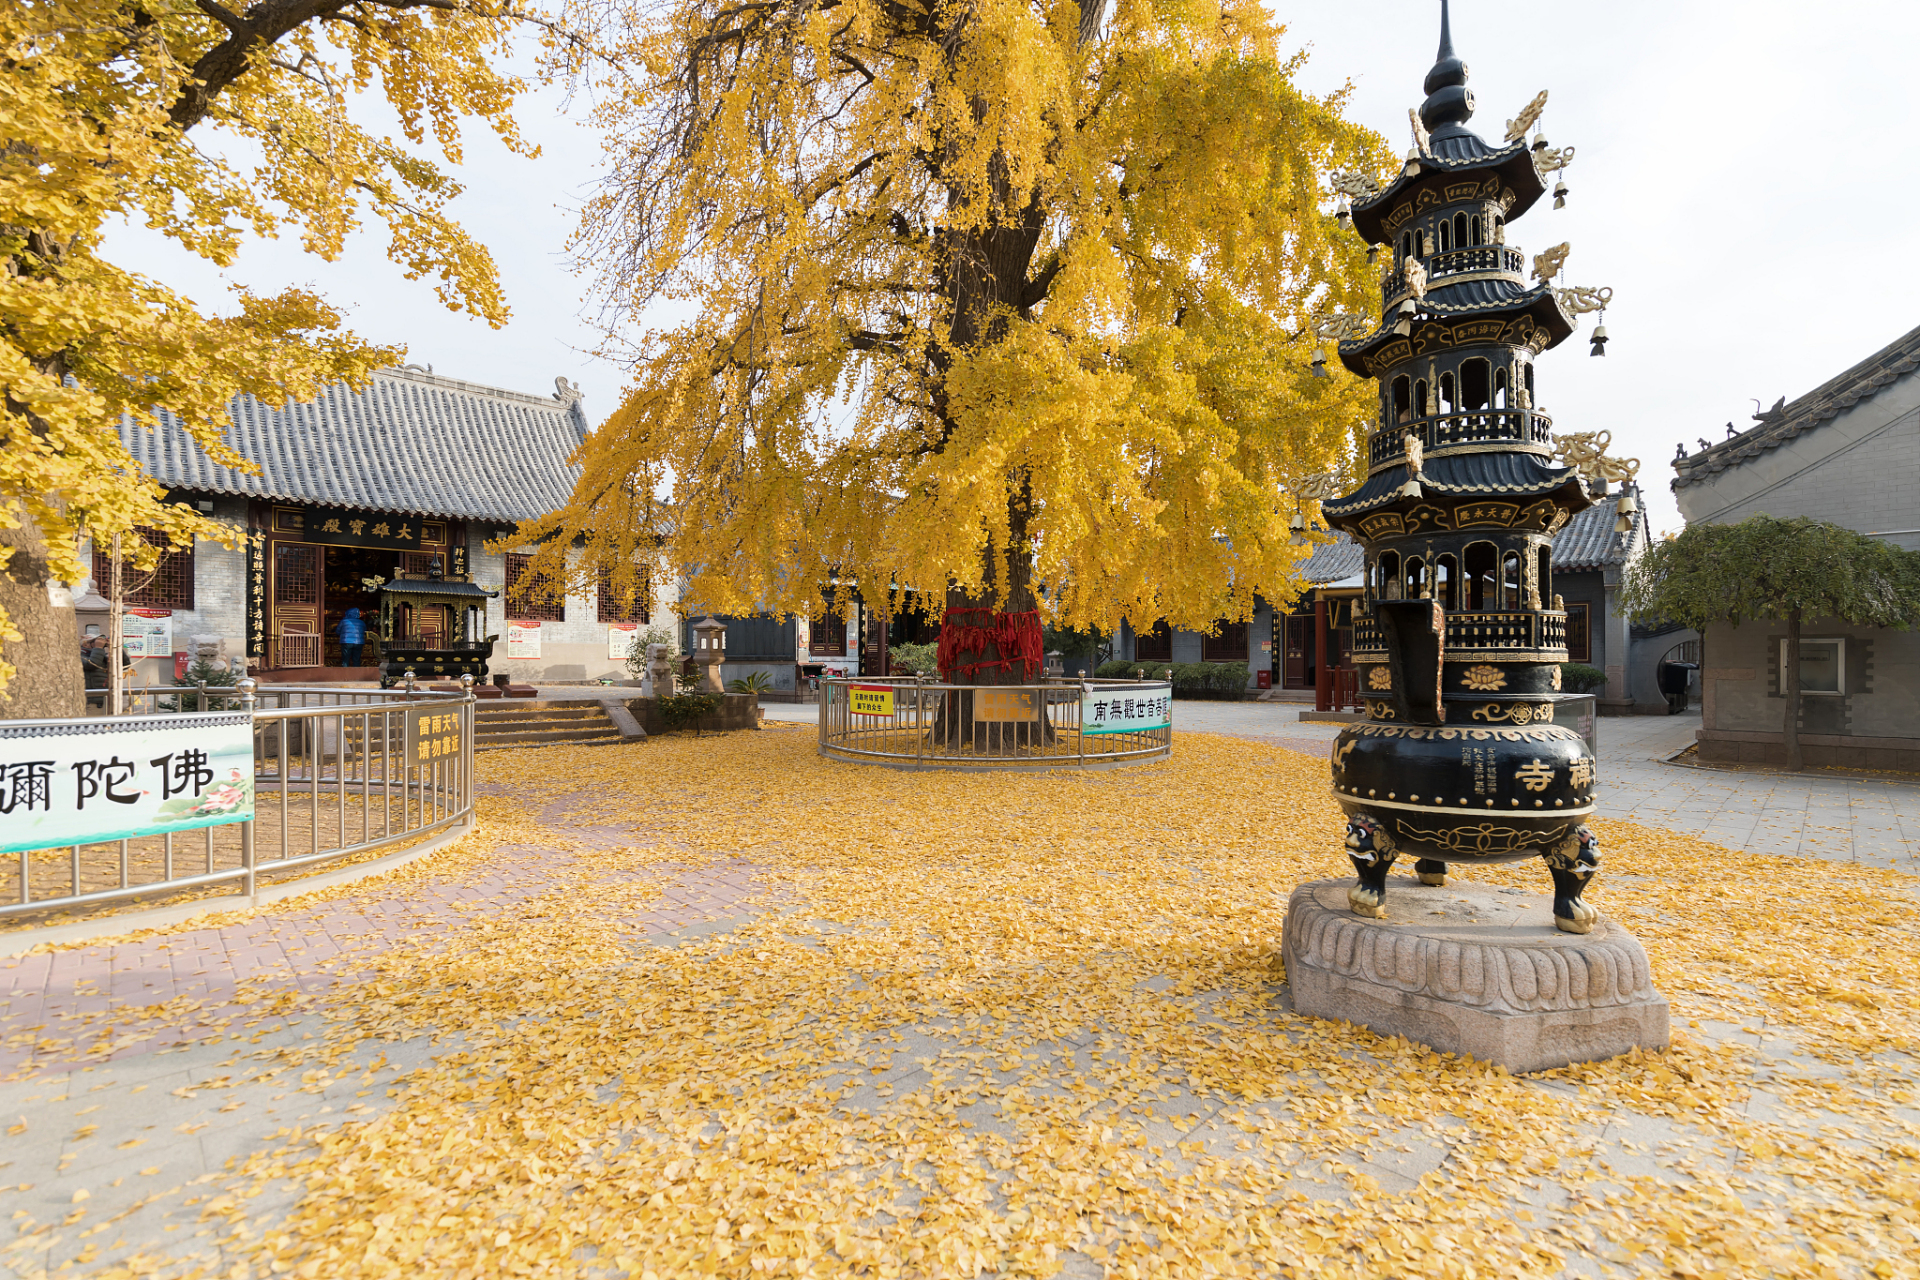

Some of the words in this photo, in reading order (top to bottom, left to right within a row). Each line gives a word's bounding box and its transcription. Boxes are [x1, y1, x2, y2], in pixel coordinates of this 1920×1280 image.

[320, 518, 413, 540] 大雄寶殿
[984, 693, 1032, 705] 雷雨天气
[418, 712, 460, 736] 雷雨天气
[983, 707, 1032, 719] 请勿靠近
[417, 734, 460, 760] 请勿靠近
[0, 748, 214, 814] 彌陀佛
[1515, 755, 1596, 792] 禪寺
